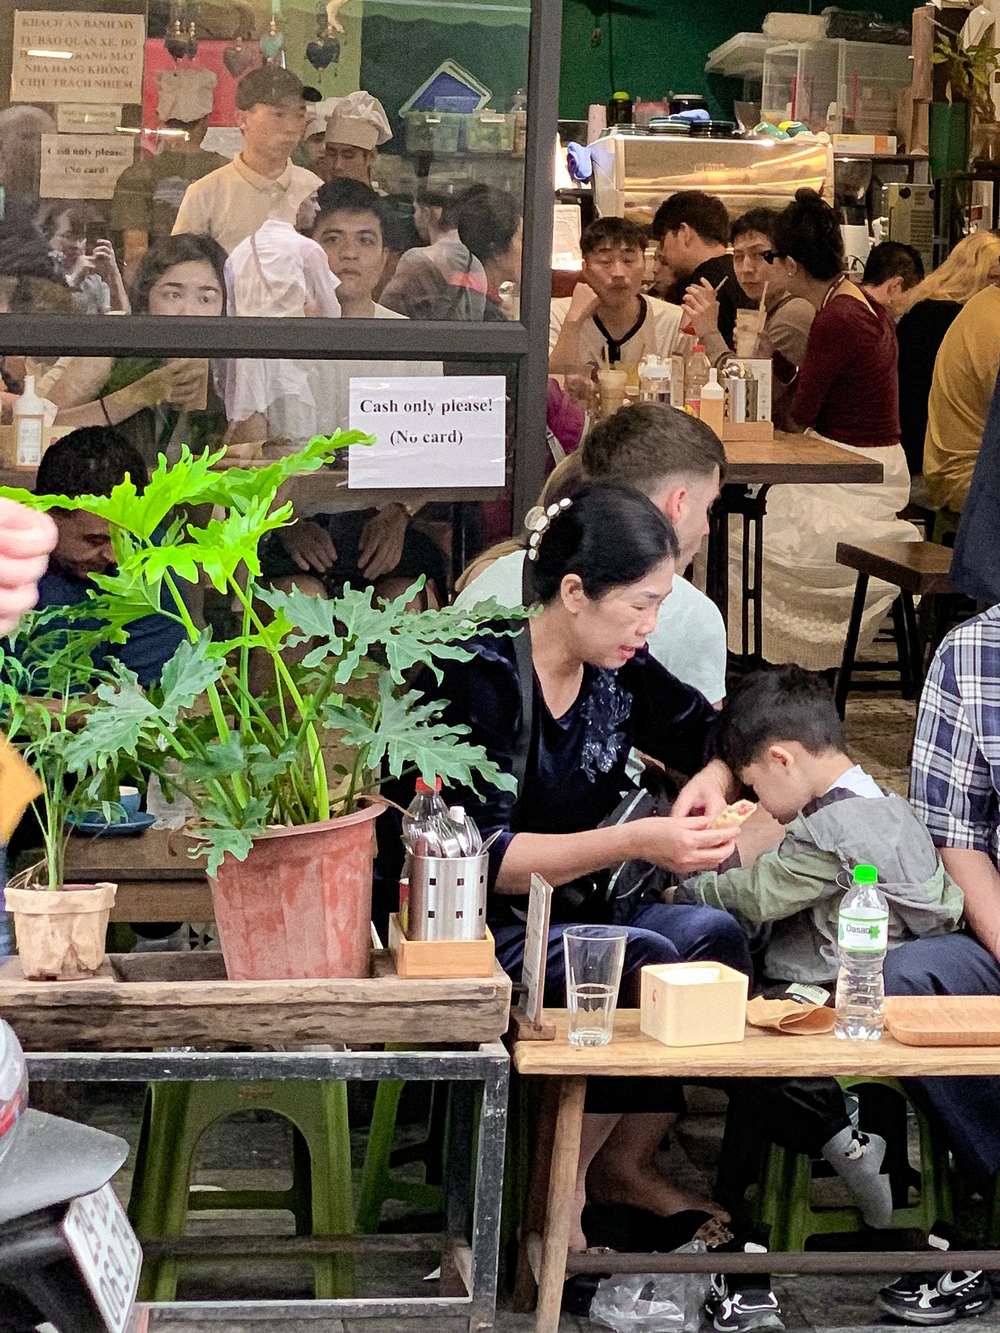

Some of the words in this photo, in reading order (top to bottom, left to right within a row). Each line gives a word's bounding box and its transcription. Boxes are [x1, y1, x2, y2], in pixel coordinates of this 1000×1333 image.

[83, 166, 109, 175] card)
[360, 398, 399, 414] Cash
[403, 399, 437, 416] only
[441, 398, 493, 416] please!
[389, 430, 418, 446] (No
[422, 429, 464, 446] card)
